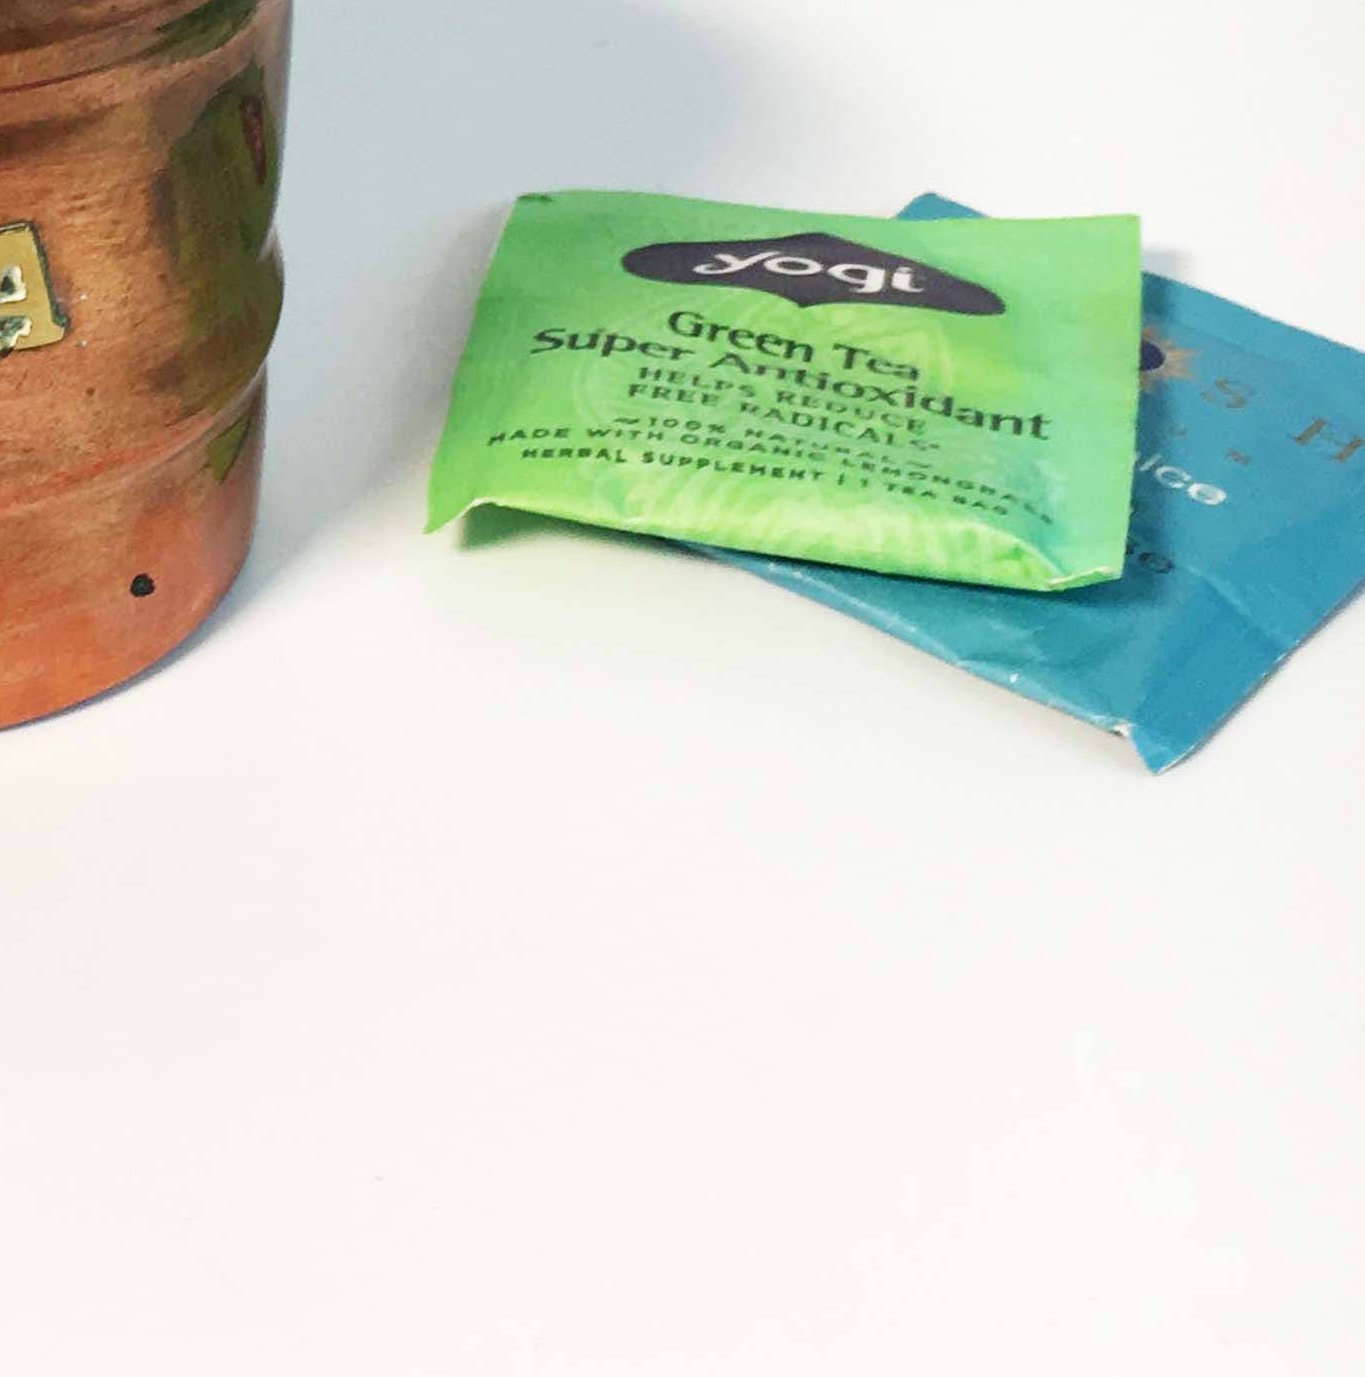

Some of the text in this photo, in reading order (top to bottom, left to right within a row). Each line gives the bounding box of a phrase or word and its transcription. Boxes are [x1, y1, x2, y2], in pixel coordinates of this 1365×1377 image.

[692, 250, 925, 294] yogi
[668, 310, 919, 381] Green Tea
[530, 327, 1052, 440] Super Antioxidant
[628, 384, 719, 407] FREE
[638, 367, 925, 434] HELPS REDUCE
[486, 428, 570, 446] MADE
[587, 429, 664, 441] WITH
[679, 434, 826, 462] ORGANIC
[522, 447, 627, 464] HERBAL
[641, 451, 824, 481] SUPPLEMENT
[885, 483, 936, 500] TEA
